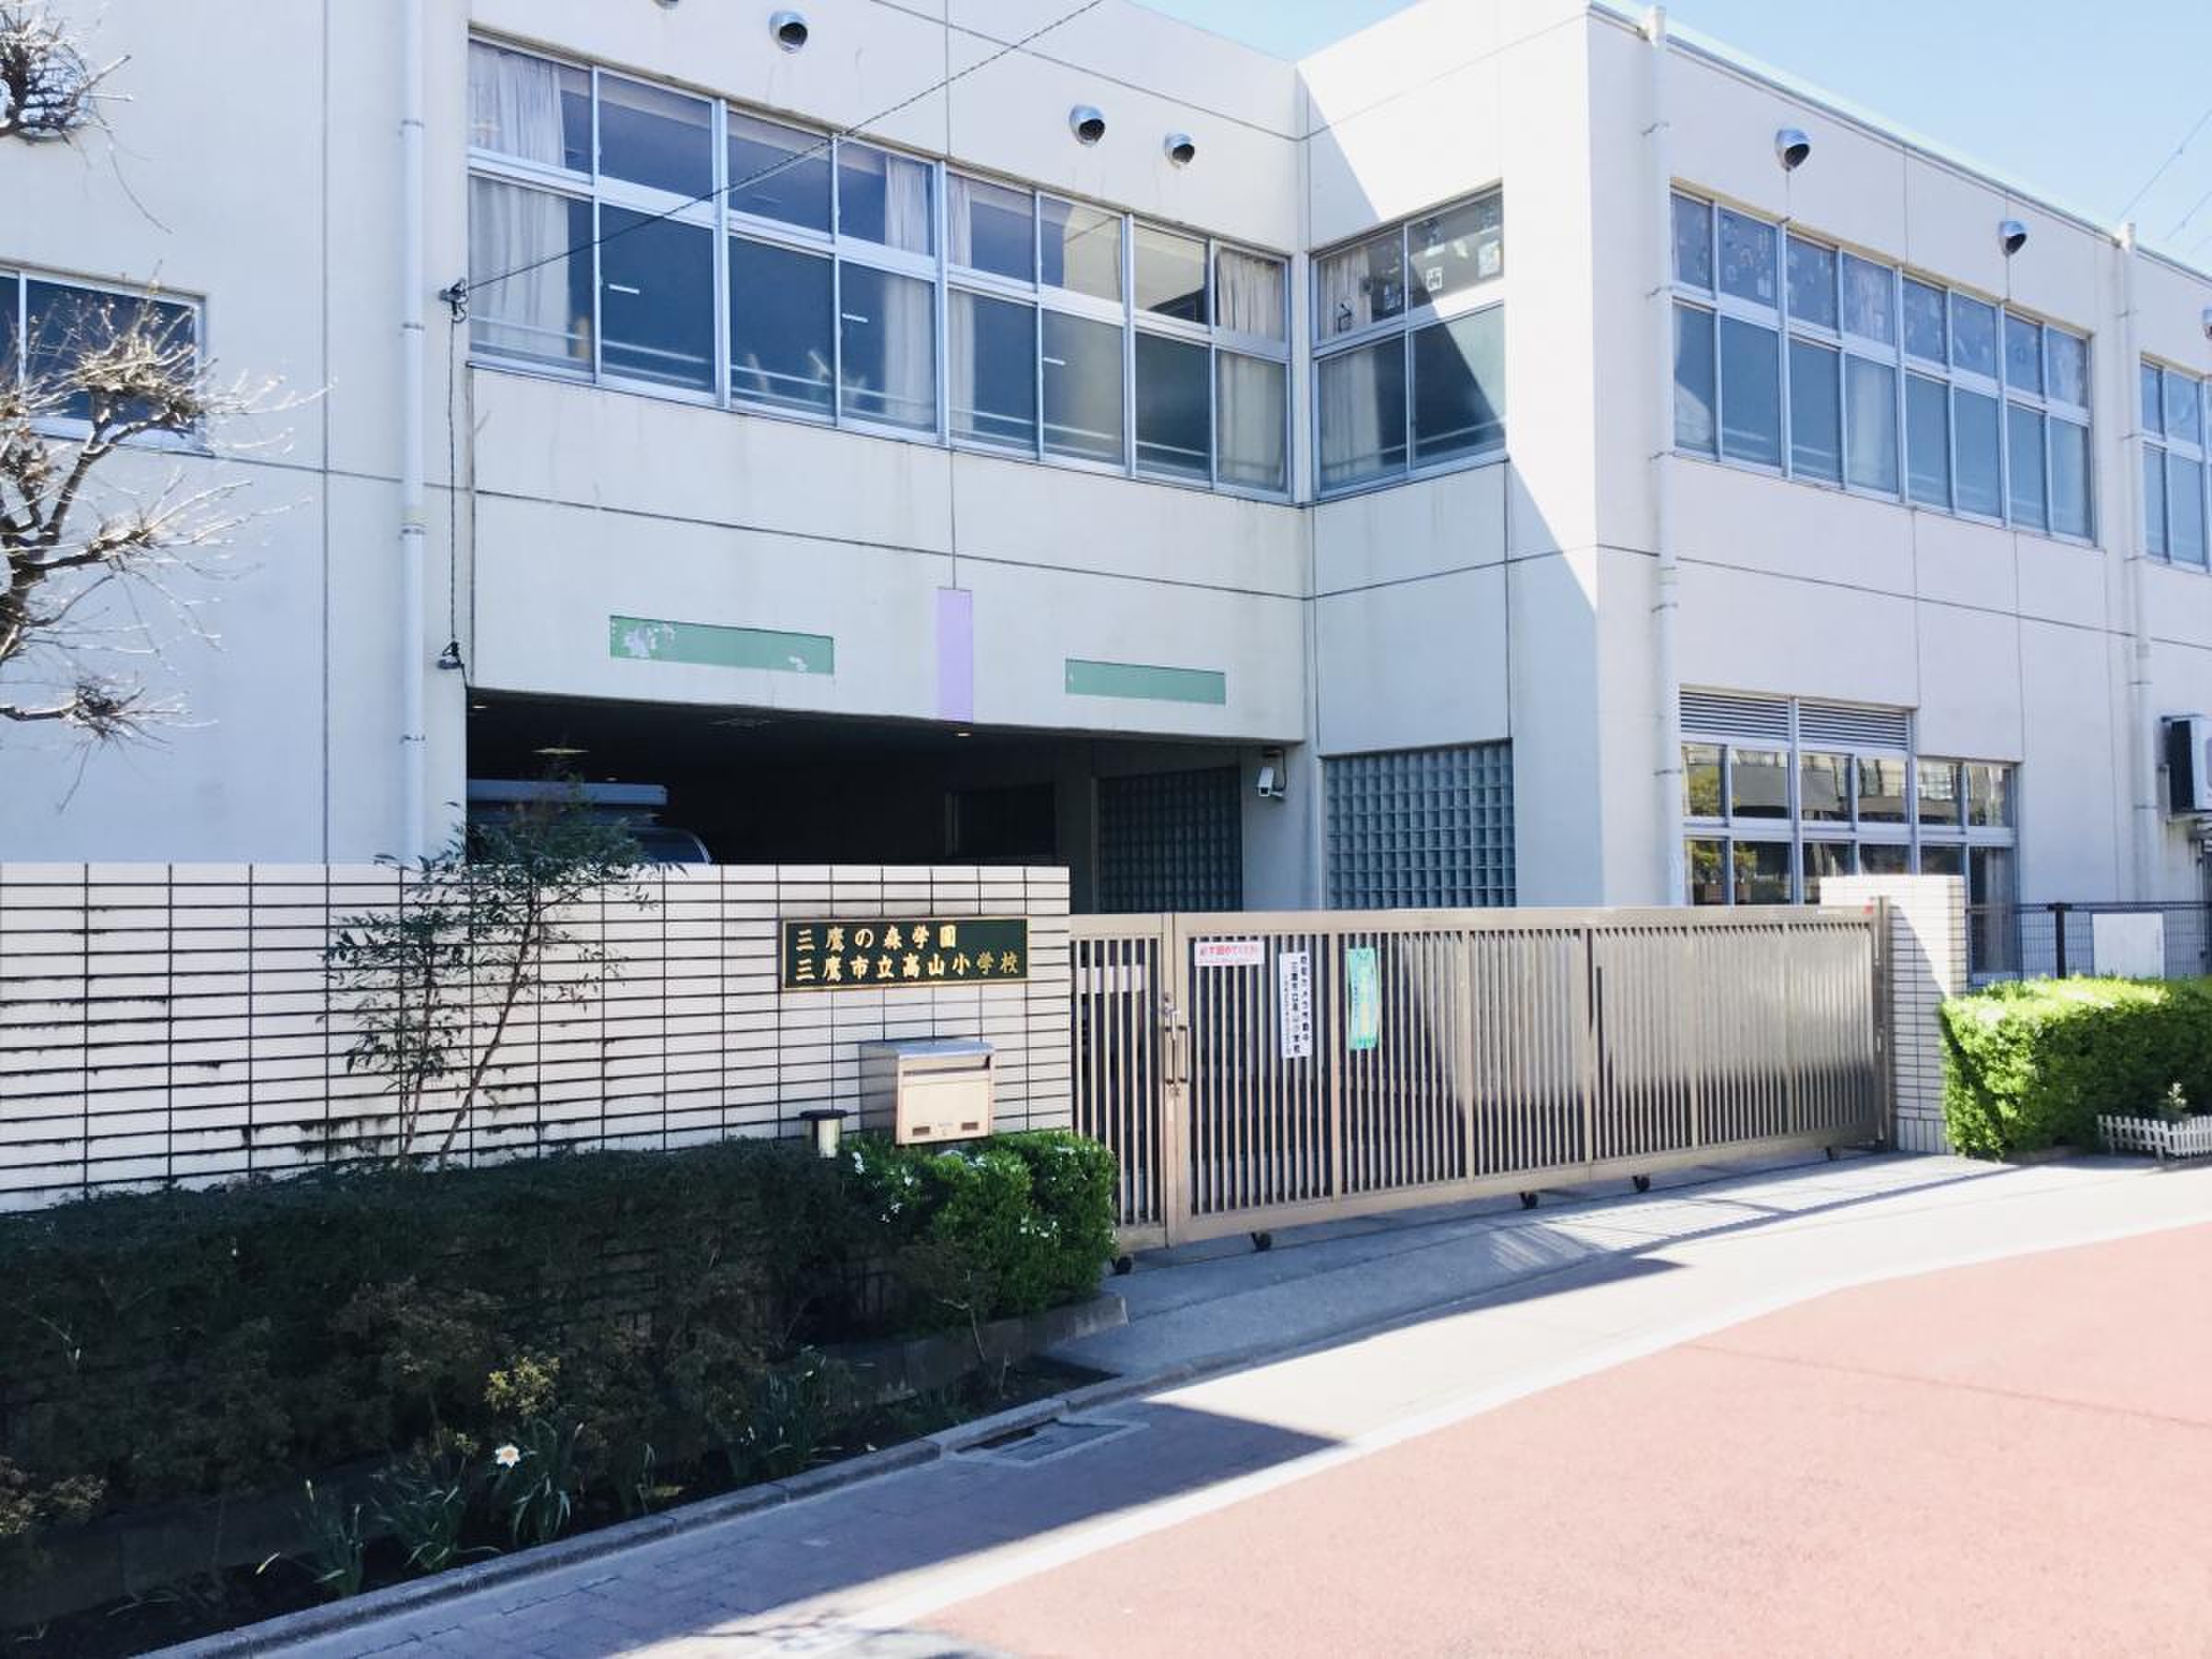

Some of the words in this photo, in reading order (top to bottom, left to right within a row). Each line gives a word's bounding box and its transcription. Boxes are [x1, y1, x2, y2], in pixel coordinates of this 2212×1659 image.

[795, 924, 958, 952] 三鷹の森学園
[795, 952, 1018, 981] 三鷹市立高山小学校
